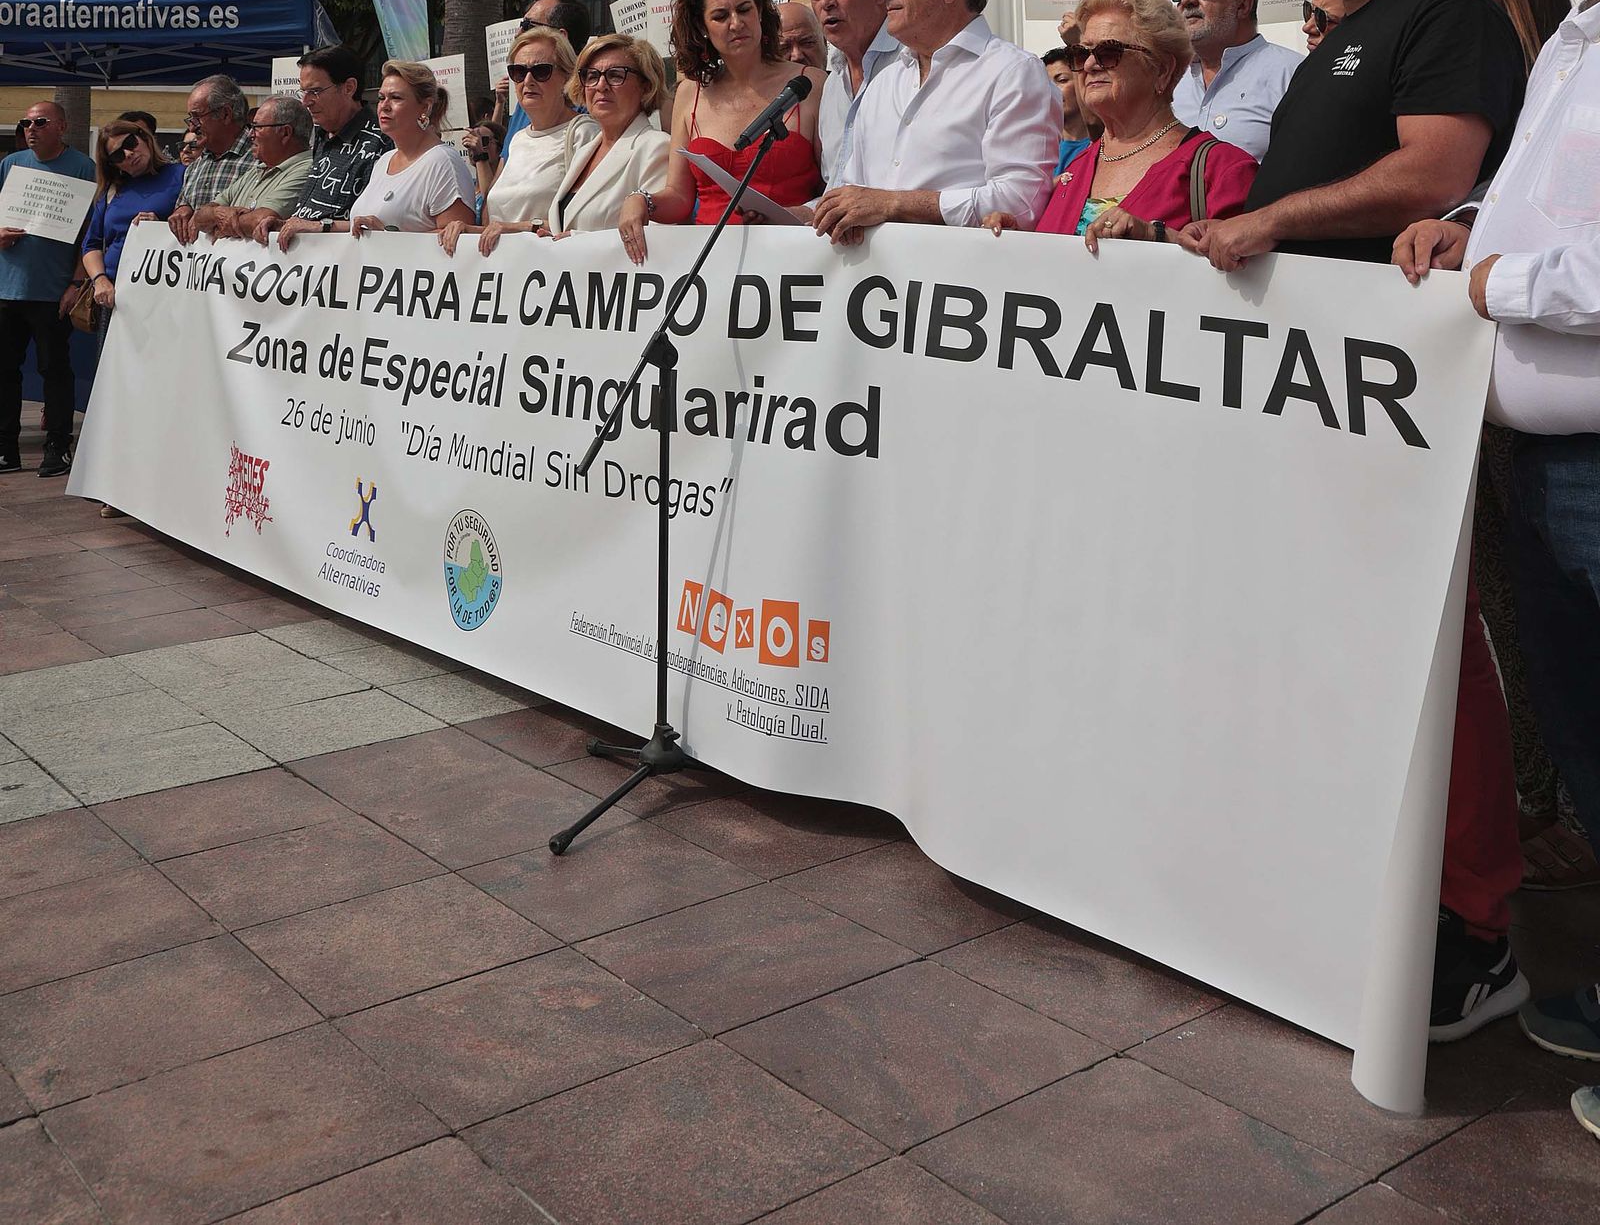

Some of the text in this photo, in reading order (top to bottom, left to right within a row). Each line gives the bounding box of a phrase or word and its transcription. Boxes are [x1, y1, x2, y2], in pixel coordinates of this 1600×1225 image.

[0, 0, 240, 29] oraalternativas.es
[45, 203, 54, 211] DE
[130, 248, 1431, 450] JUSTICIA SOCIAL PARA EL CAMPO DE GIBRALTAR
[226, 321, 307, 374] Zona
[318, 333, 353, 382] de
[360, 337, 509, 408] Especial
[281, 397, 305, 428] 26
[310, 405, 332, 434] de
[335, 409, 376, 446] junio
[448, 432, 535, 483] Mundial
[545, 451, 589, 494] Sin
[326, 541, 386, 574] Coordinadora
[446, 531, 457, 560] POR
[454, 518, 464, 535] TU
[464, 515, 499, 572] SEGURIDAD
[317, 561, 381, 598] Alternativas
[447, 567, 457, 597] POR
[453, 597, 463, 617] LA
[462, 609, 473, 624] DE
[570, 611, 608, 641] Federación
[609, 624, 645, 654] Provincial
[644, 636, 653, 657] de
[795, 684, 830, 710] SIDA
[726, 699, 828, 741] y Patología Dual.
